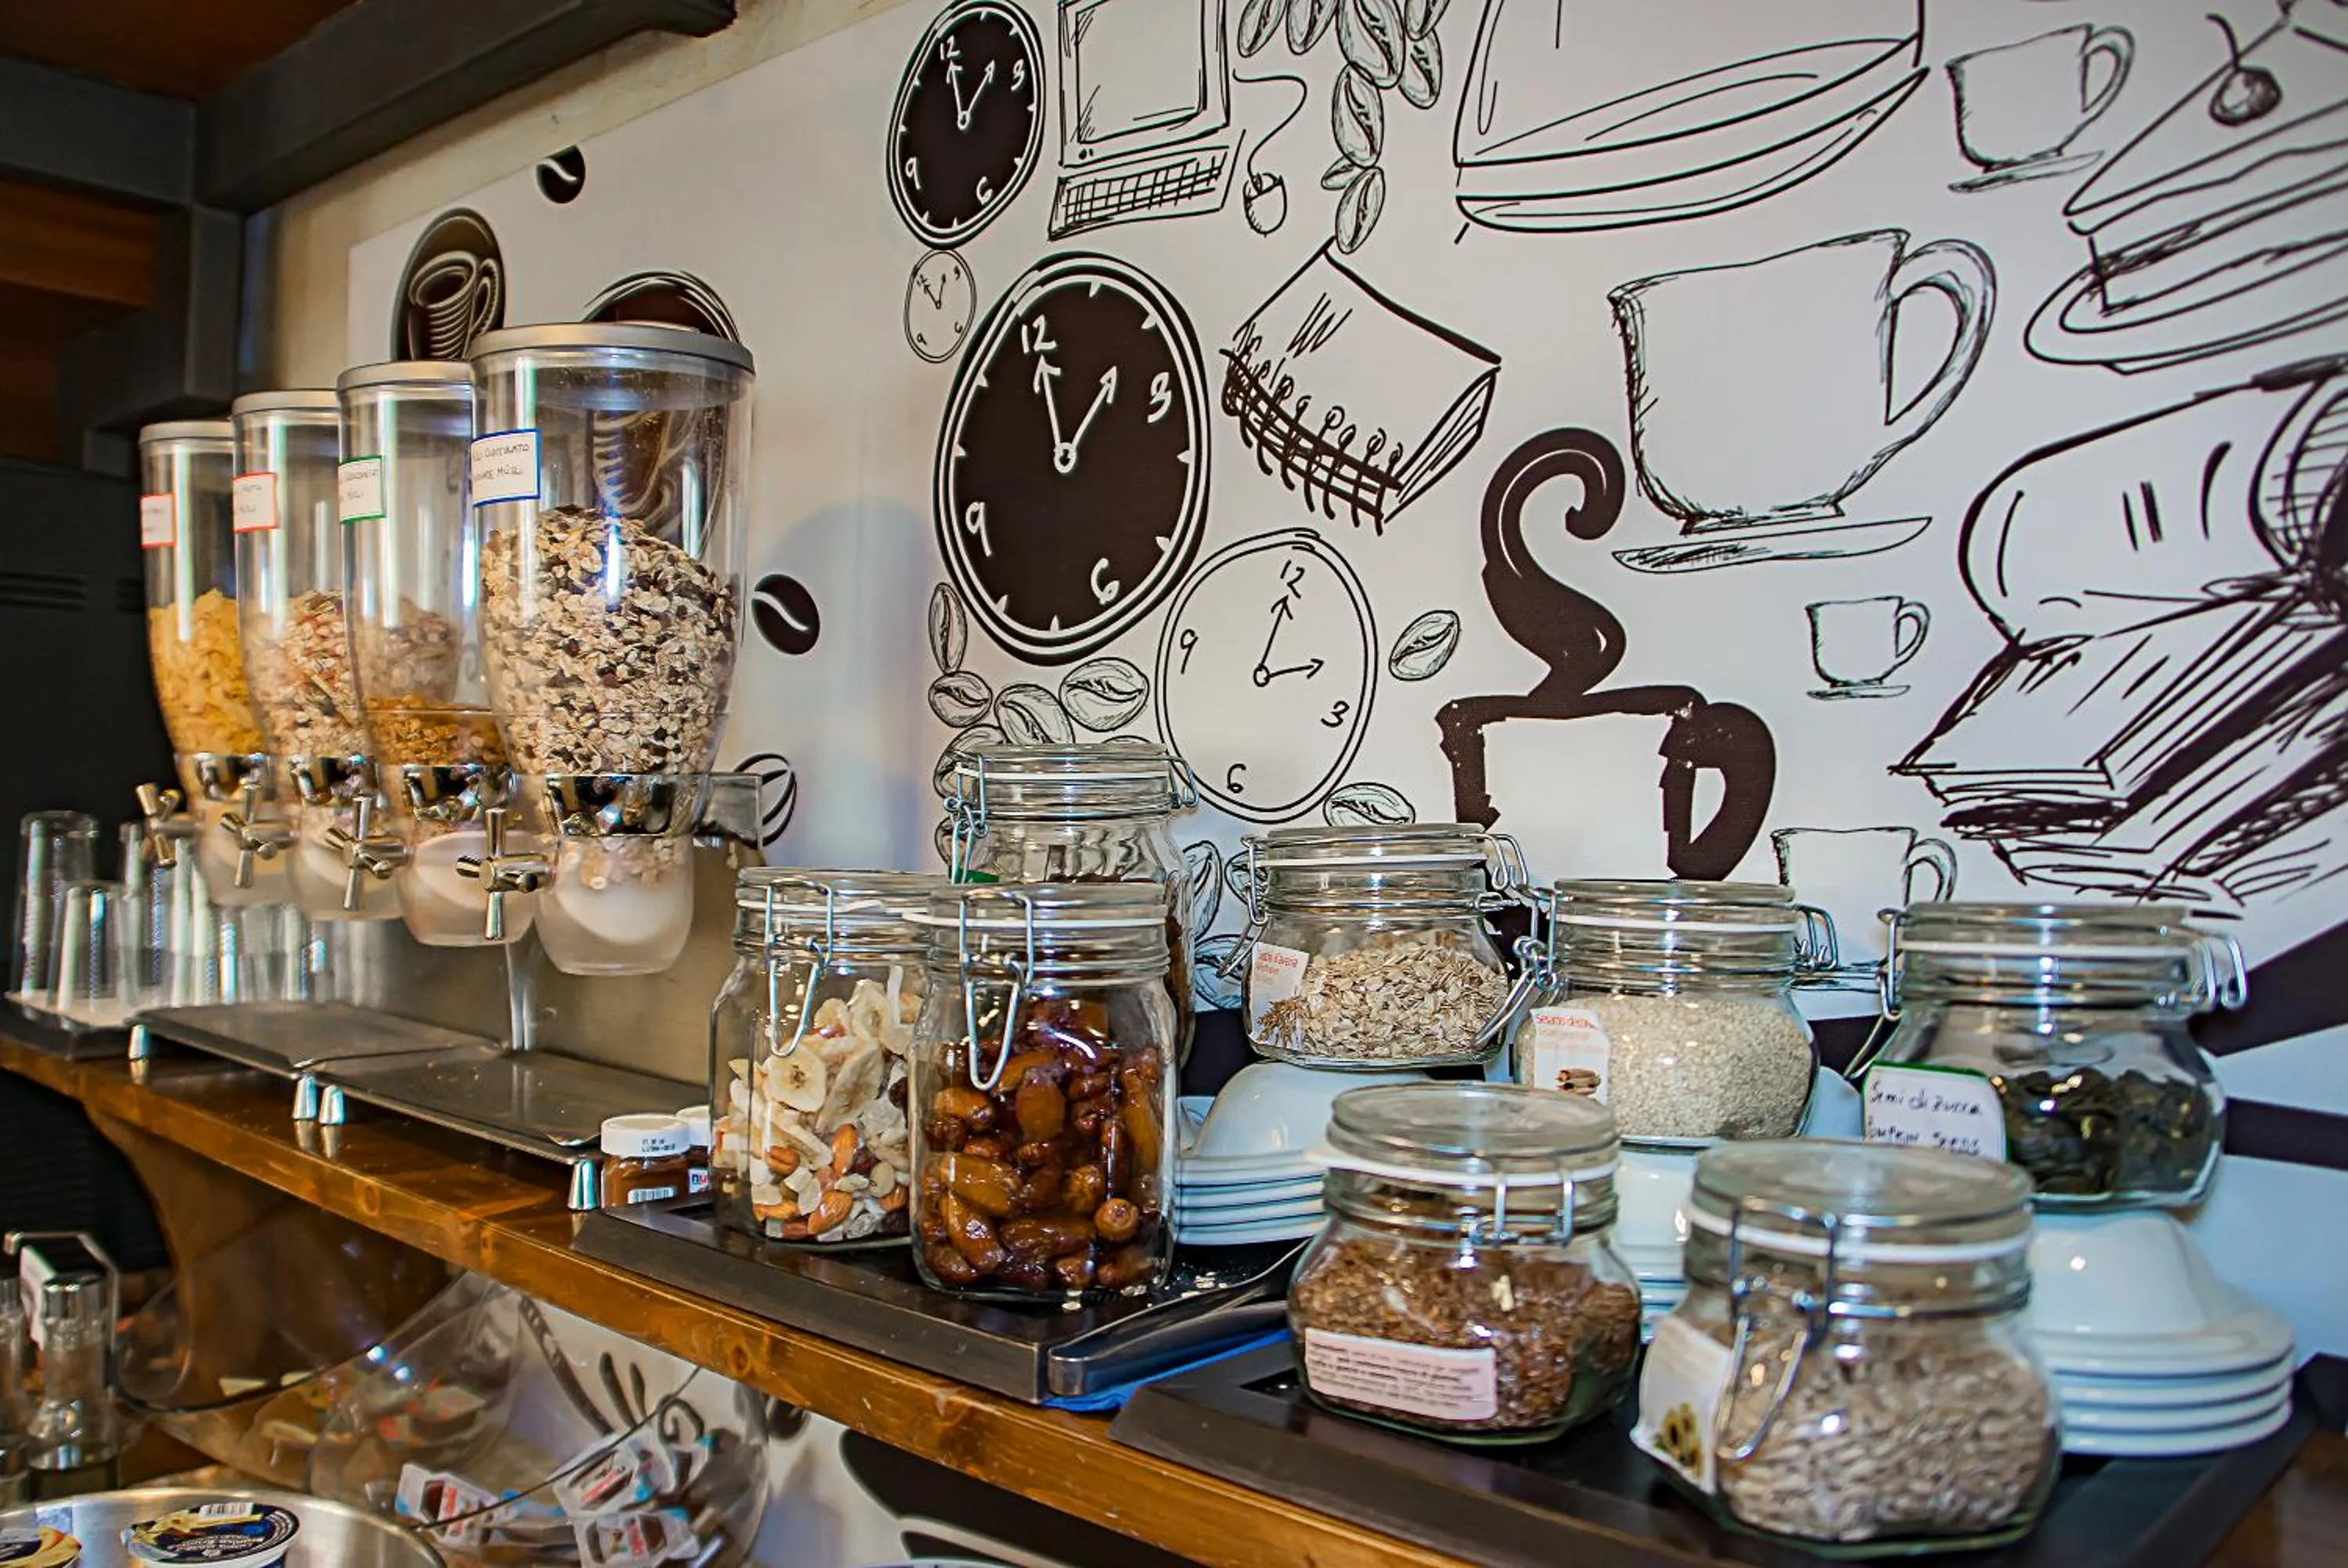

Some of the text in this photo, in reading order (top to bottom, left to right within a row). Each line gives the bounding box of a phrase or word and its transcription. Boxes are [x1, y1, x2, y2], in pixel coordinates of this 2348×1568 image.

[940, 34, 961, 61] 12
[905, 156, 922, 190] 9
[976, 176, 994, 205] 6
[1021, 314, 1057, 354] 12
[964, 500, 994, 558] 9
[1089, 556, 1121, 606] 6
[1280, 559, 1306, 599] 12
[1179, 628, 1200, 675] 9
[1320, 699, 1350, 728] 3
[1226, 762, 1247, 794] 6
